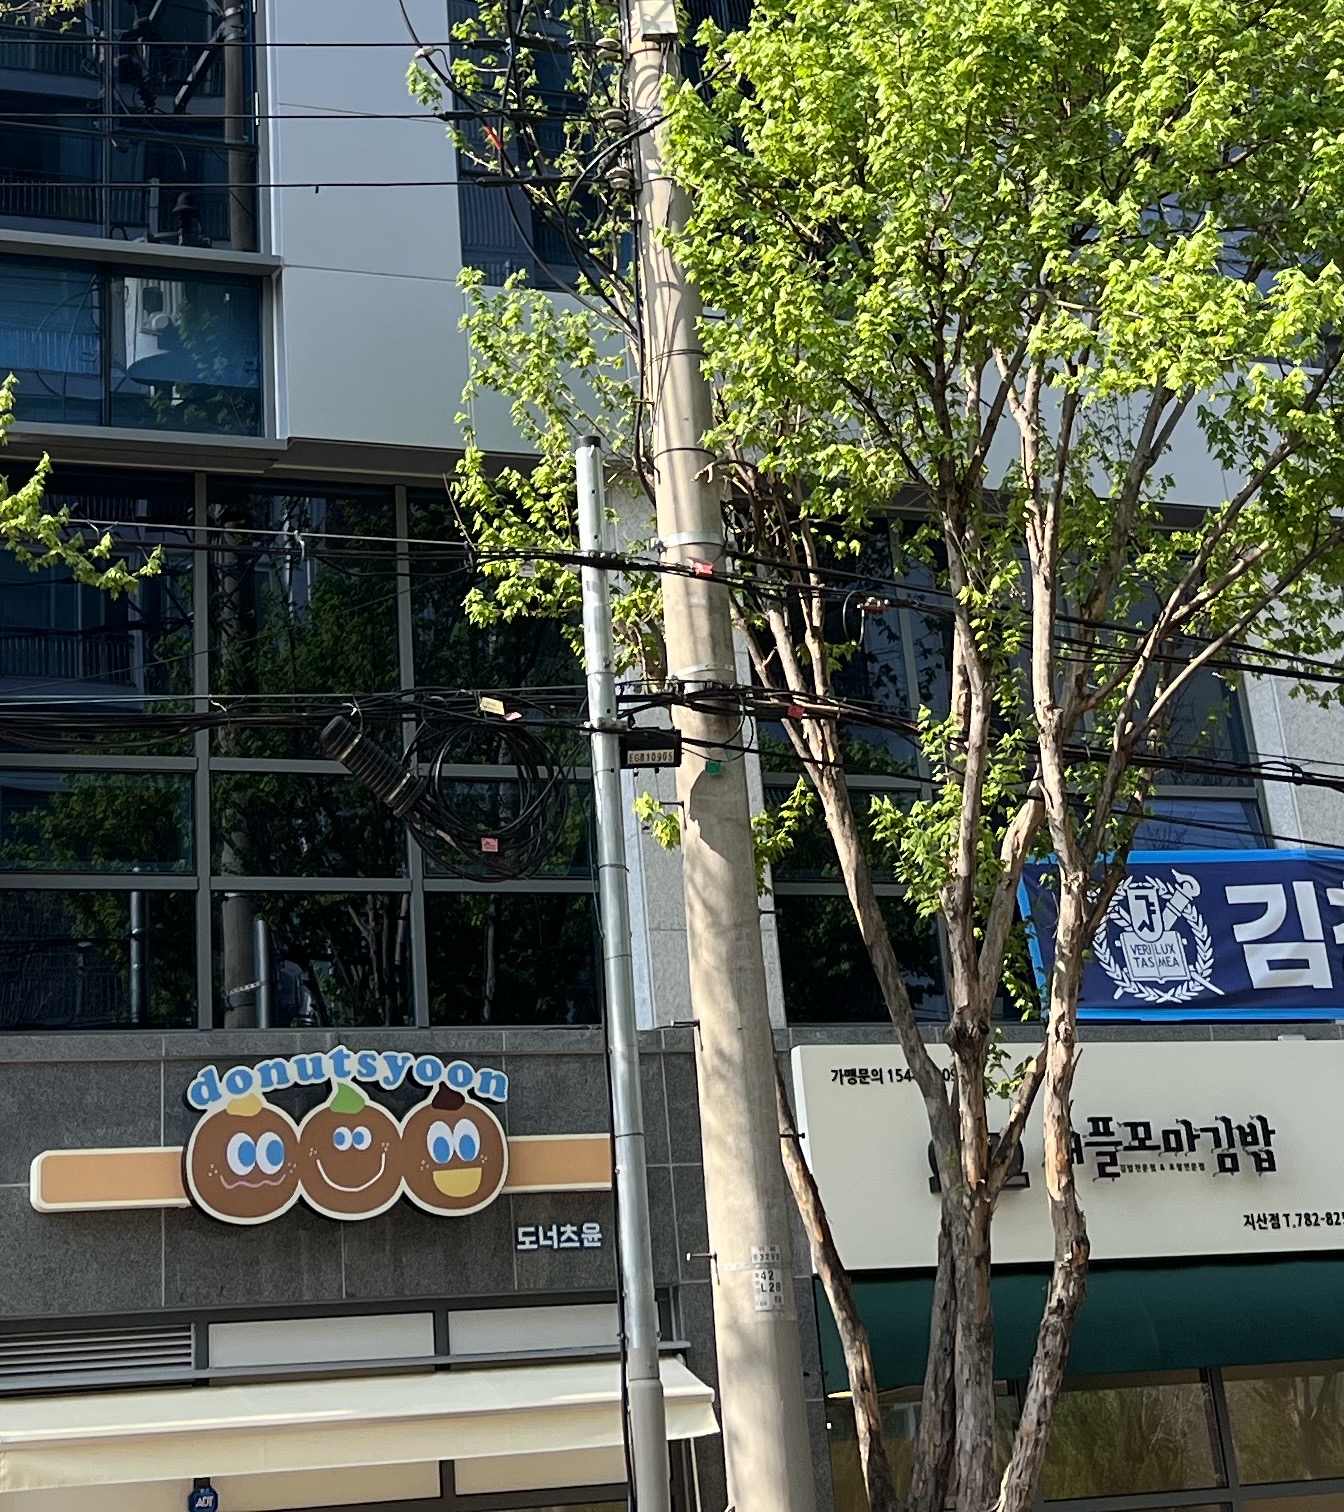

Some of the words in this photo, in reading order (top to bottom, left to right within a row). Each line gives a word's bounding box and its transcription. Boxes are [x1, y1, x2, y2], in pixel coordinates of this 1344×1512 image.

[1130, 944, 1152, 955] VERI
[1154, 943, 1175, 954] LUX
[1133, 957, 1155, 968] TAS
[1158, 956, 1179, 967] MEA
[188, 1044, 509, 1107] donutsyoon
[830, 1067, 884, 1086] 가맹문의
[1243, 1214, 1281, 1230] 지산점
[516, 1222, 603, 1250] 도너츠윤
[195, 1496, 214, 1508] ADT
